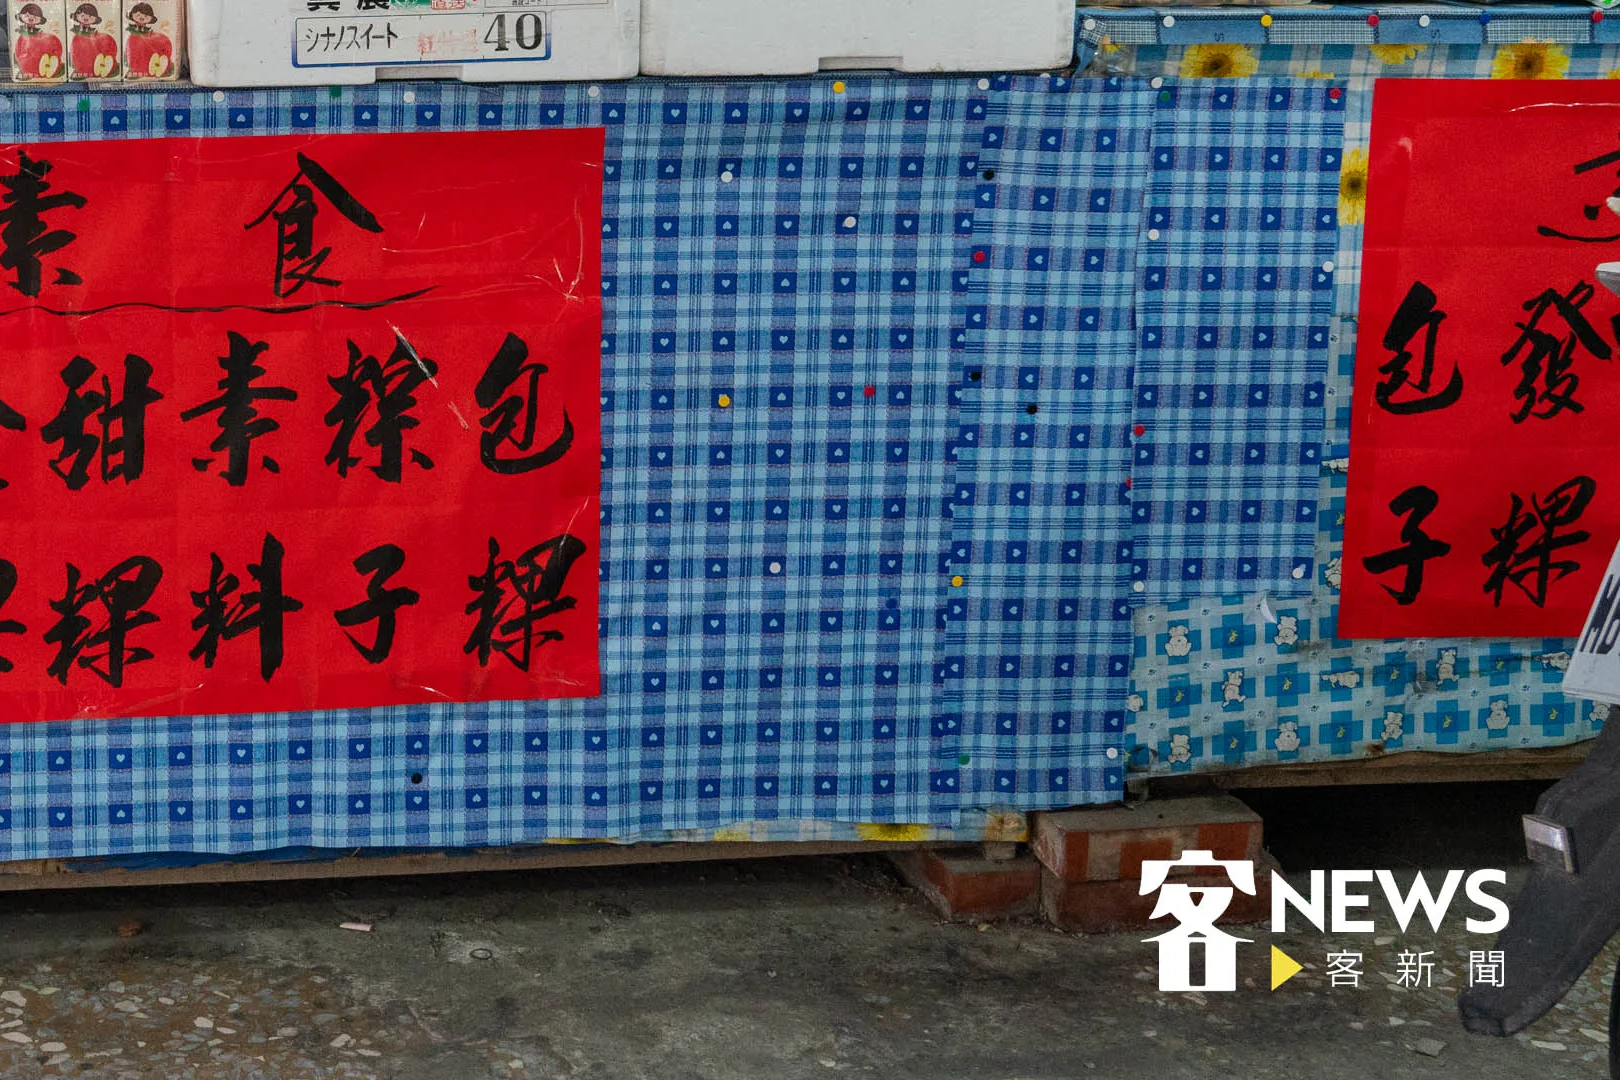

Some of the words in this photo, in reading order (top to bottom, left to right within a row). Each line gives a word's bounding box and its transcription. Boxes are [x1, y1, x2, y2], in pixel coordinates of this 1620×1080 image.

[305, 22, 398, 52] シナノスイート
[483, 13, 542, 52] 40
